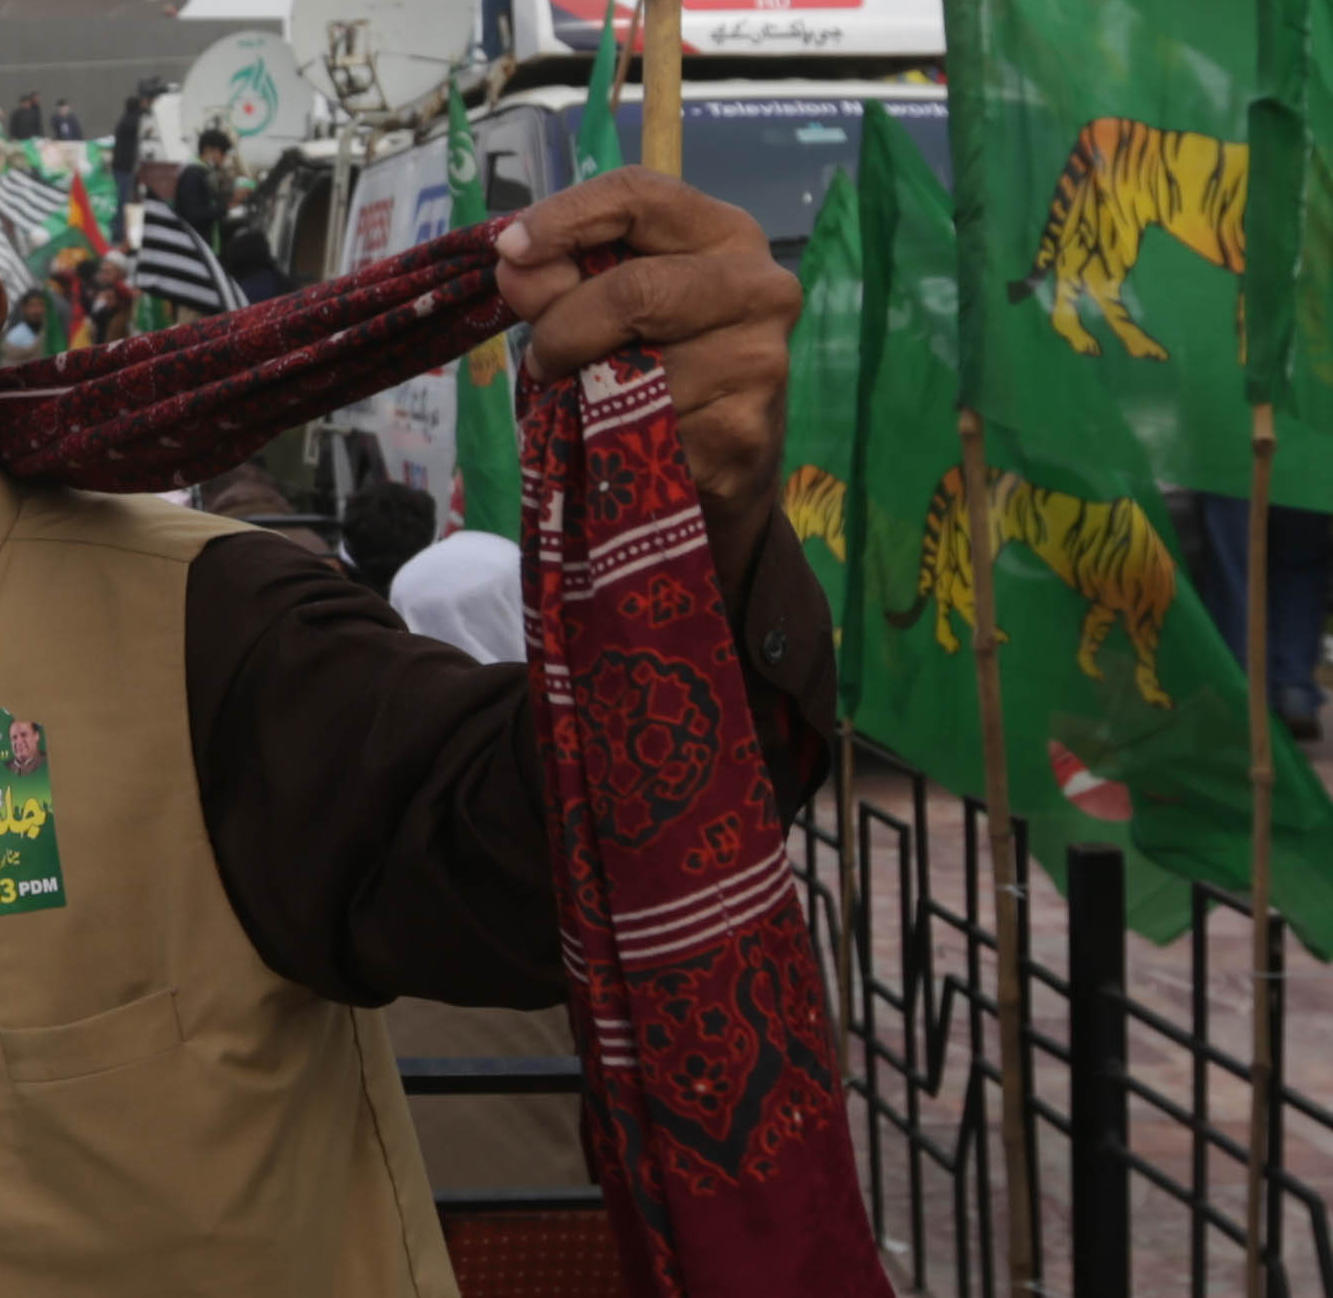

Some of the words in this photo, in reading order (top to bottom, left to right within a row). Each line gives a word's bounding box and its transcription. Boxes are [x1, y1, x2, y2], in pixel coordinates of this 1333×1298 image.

[704, 99, 837, 117] Television
[839, 98, 948, 118] Nwork
[18, 877, 59, 897] PDM
